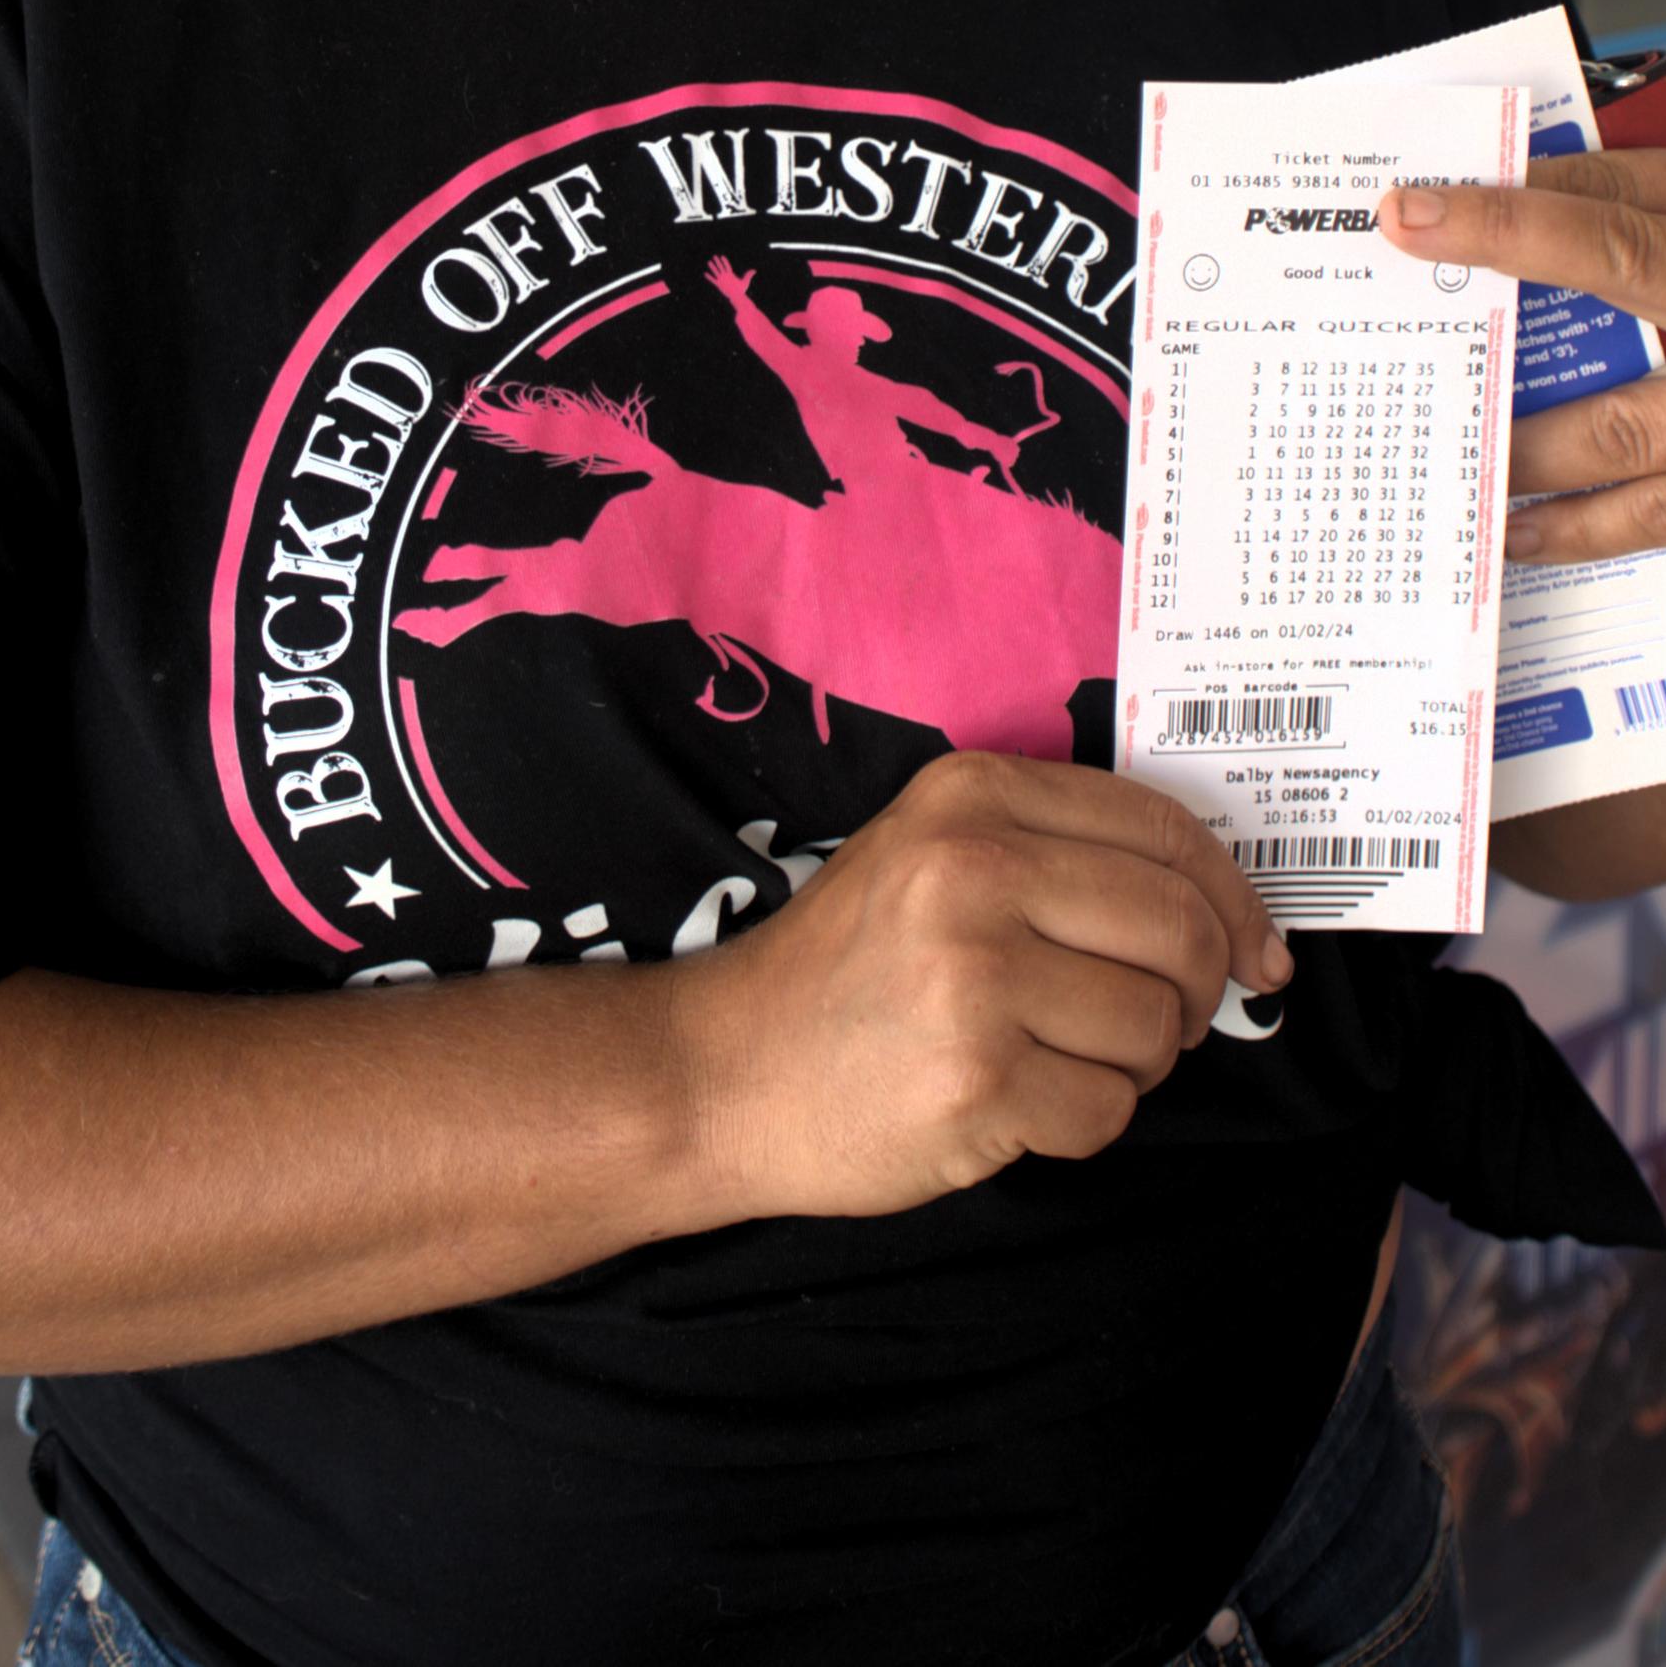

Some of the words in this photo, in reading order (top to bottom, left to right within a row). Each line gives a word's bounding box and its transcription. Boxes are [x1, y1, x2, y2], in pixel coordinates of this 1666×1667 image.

[1547, 97, 1563, 112] or
[1560, 93, 1573, 108] all
[1274, 152, 1331, 166] Ticket
[1342, 153, 1401, 166] Number
[1190, 175, 1210, 189] 01
[1223, 175, 1282, 189] 163485
[1292, 175, 1341, 189] 93814
[1351, 176, 1380, 189] 001
[1283, 266, 1324, 280] Good
[1334, 266, 1374, 280] Luck
[1523, 294, 1546, 313] the
[1524, 307, 1572, 331] panels
[1165, 320, 1296, 333] REGULAR
[1318, 320, 1489, 335] QUICKPICK
[1513, 332, 1555, 353] tches
[1556, 321, 1589, 341] with
[1161, 343, 1201, 355] GAME
[1469, 343, 1488, 356] PB
[1523, 349, 1550, 367] and
[1253, 361, 1263, 375] 3
[1280, 362, 1292, 375] 8
[1301, 362, 1319, 376] 12
[1329, 362, 1349, 376] 13
[1359, 363, 1378, 376] 14
[1386, 362, 1407, 376] 27
[1418, 363, 1436, 376] 35
[1465, 362, 1486, 377] 18
[1527, 373, 1556, 392] won
[1558, 368, 1578, 385] on
[1579, 360, 1608, 380] this
[1249, 425, 1258, 438] 3
[1269, 425, 1289, 439] 10
[1298, 425, 1317, 439] 13
[1325, 425, 1345, 439] 22
[1353, 425, 1375, 439] 24
[1382, 425, 1403, 439] 27
[1412, 425, 1432, 438] 34
[1461, 425, 1481, 439] 11
[1237, 466, 1257, 481] 10
[1266, 467, 1284, 480] 11
[1296, 467, 1314, 480] 13
[1323, 466, 1343, 480] 15
[1352, 466, 1373, 480] 30
[1381, 466, 1399, 480] 31
[1409, 466, 1429, 480] 34
[1460, 467, 1479, 481] 13
[257, 344, 436, 842] BUCKED
[421, 162, 611, 336] OFF
[638, 125, 1139, 326] WESTER
[1233, 530, 1252, 544] 11
[1262, 529, 1282, 543] 14
[1291, 529, 1311, 543] 17
[1318, 529, 1340, 543] 20
[1347, 529, 1368, 542] 26
[1377, 529, 1397, 542] 30
[1405, 529, 1425, 542] 32
[1456, 530, 1476, 543] 19
[1508, 613, 1550, 631] Signature:
[1154, 630, 1194, 642] Draw
[1204, 626, 1242, 641] 1446
[1249, 629, 1269, 639] on
[1278, 623, 1354, 639] 01/02/24
[1184, 663, 1206, 673] Ask
[1215, 660, 1275, 673] in-store
[1282, 659, 1305, 670] for
[1312, 658, 1342, 670] FREE
[1204, 683, 1229, 694] POS
[1243, 680, 1299, 694] Barcode
[1419, 701, 1467, 714] TOTAL
[1409, 721, 1468, 737] $16.15
[1225, 767, 1274, 785] Dalby
[1282, 766, 1381, 783] Newsagency
[1254, 790, 1272, 804] 15
[1281, 788, 1331, 803] 08606
[1338, 787, 1350, 802] 2
[1263, 808, 1338, 825] 10:16:53
[1365, 809, 1463, 826] 01/02/2024
